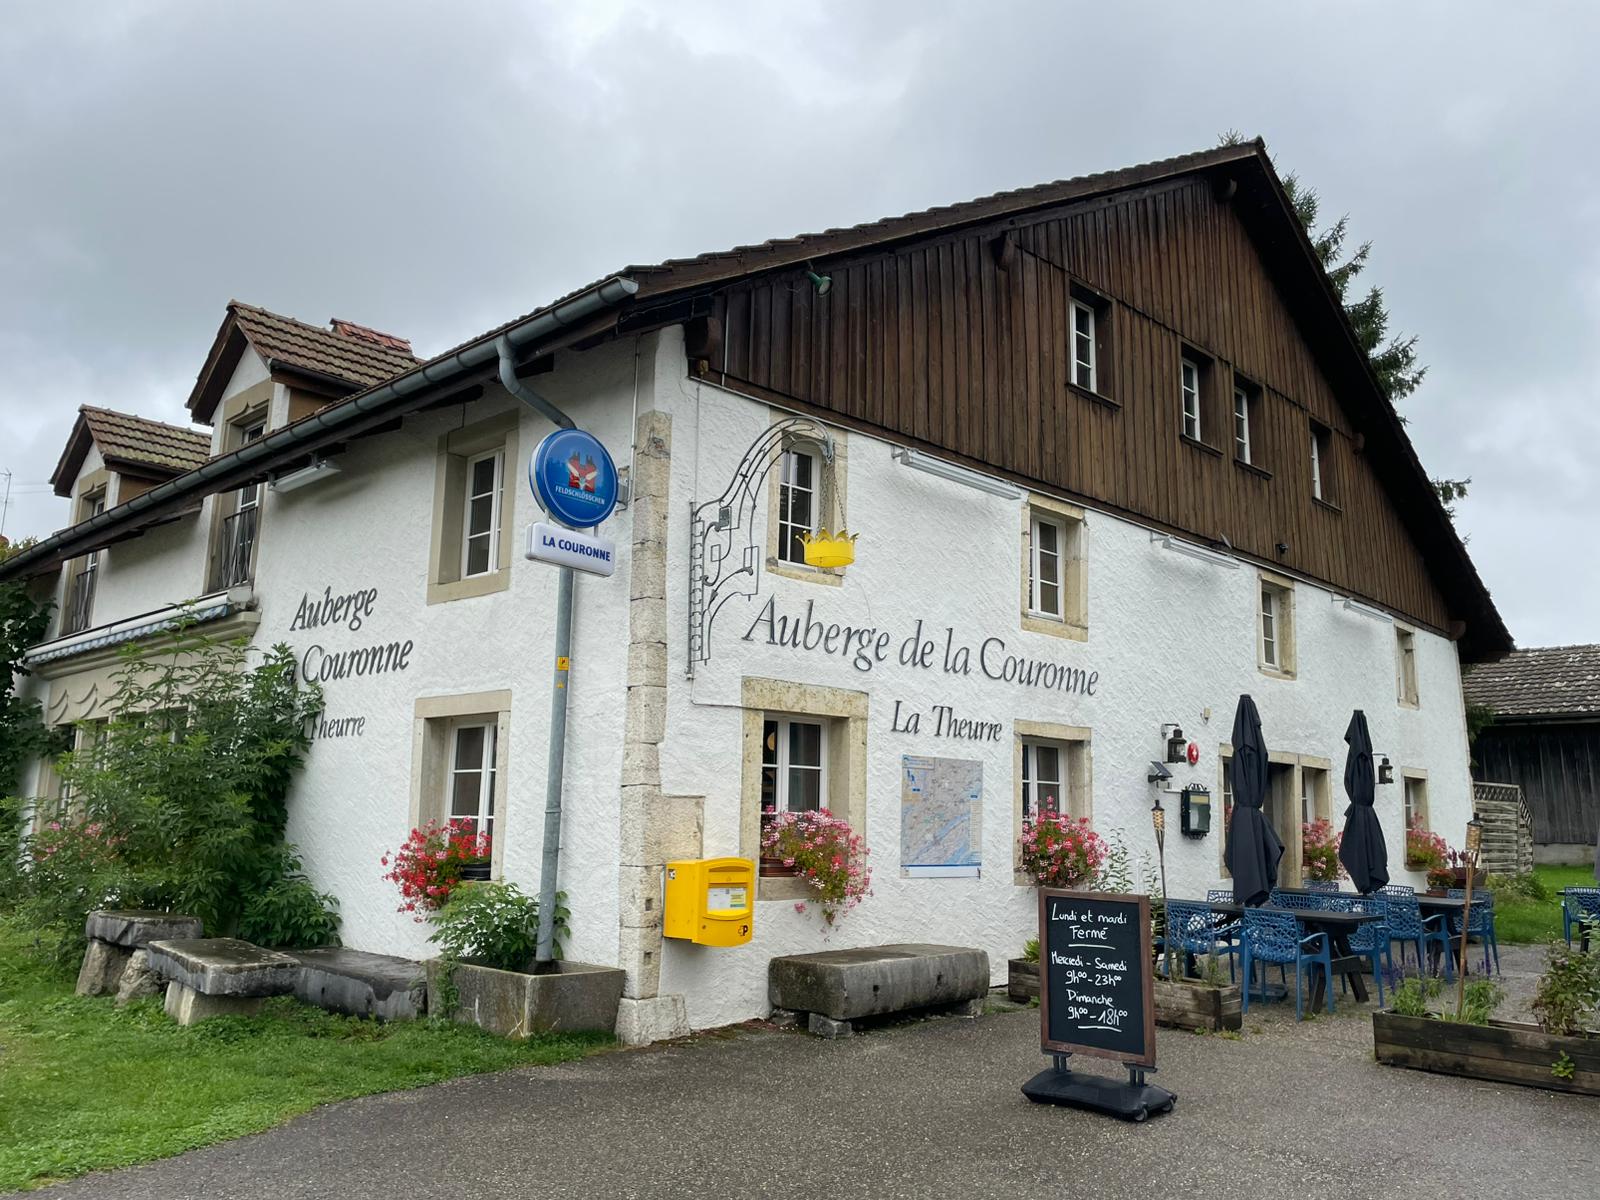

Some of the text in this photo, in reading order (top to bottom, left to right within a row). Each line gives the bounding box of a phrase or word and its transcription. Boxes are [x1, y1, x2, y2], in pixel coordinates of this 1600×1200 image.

[555, 485, 605, 505] FELDSCHLÖSSCHEN
[543, 535, 610, 562] LA COURONNE
[290, 586, 377, 631] Auberge
[741, 592, 1100, 697] Auberge de la Couronne
[302, 639, 414, 684] Couronne
[890, 700, 1002, 742] La Theurre
[1051, 903, 1127, 924] Lundi et mardi
[1069, 925, 1108, 940] Fermé
[1051, 951, 1083, 966] Mercredi
[1094, 957, 1127, 972] Samedi
[1066, 989, 1114, 1008] Dimanche
